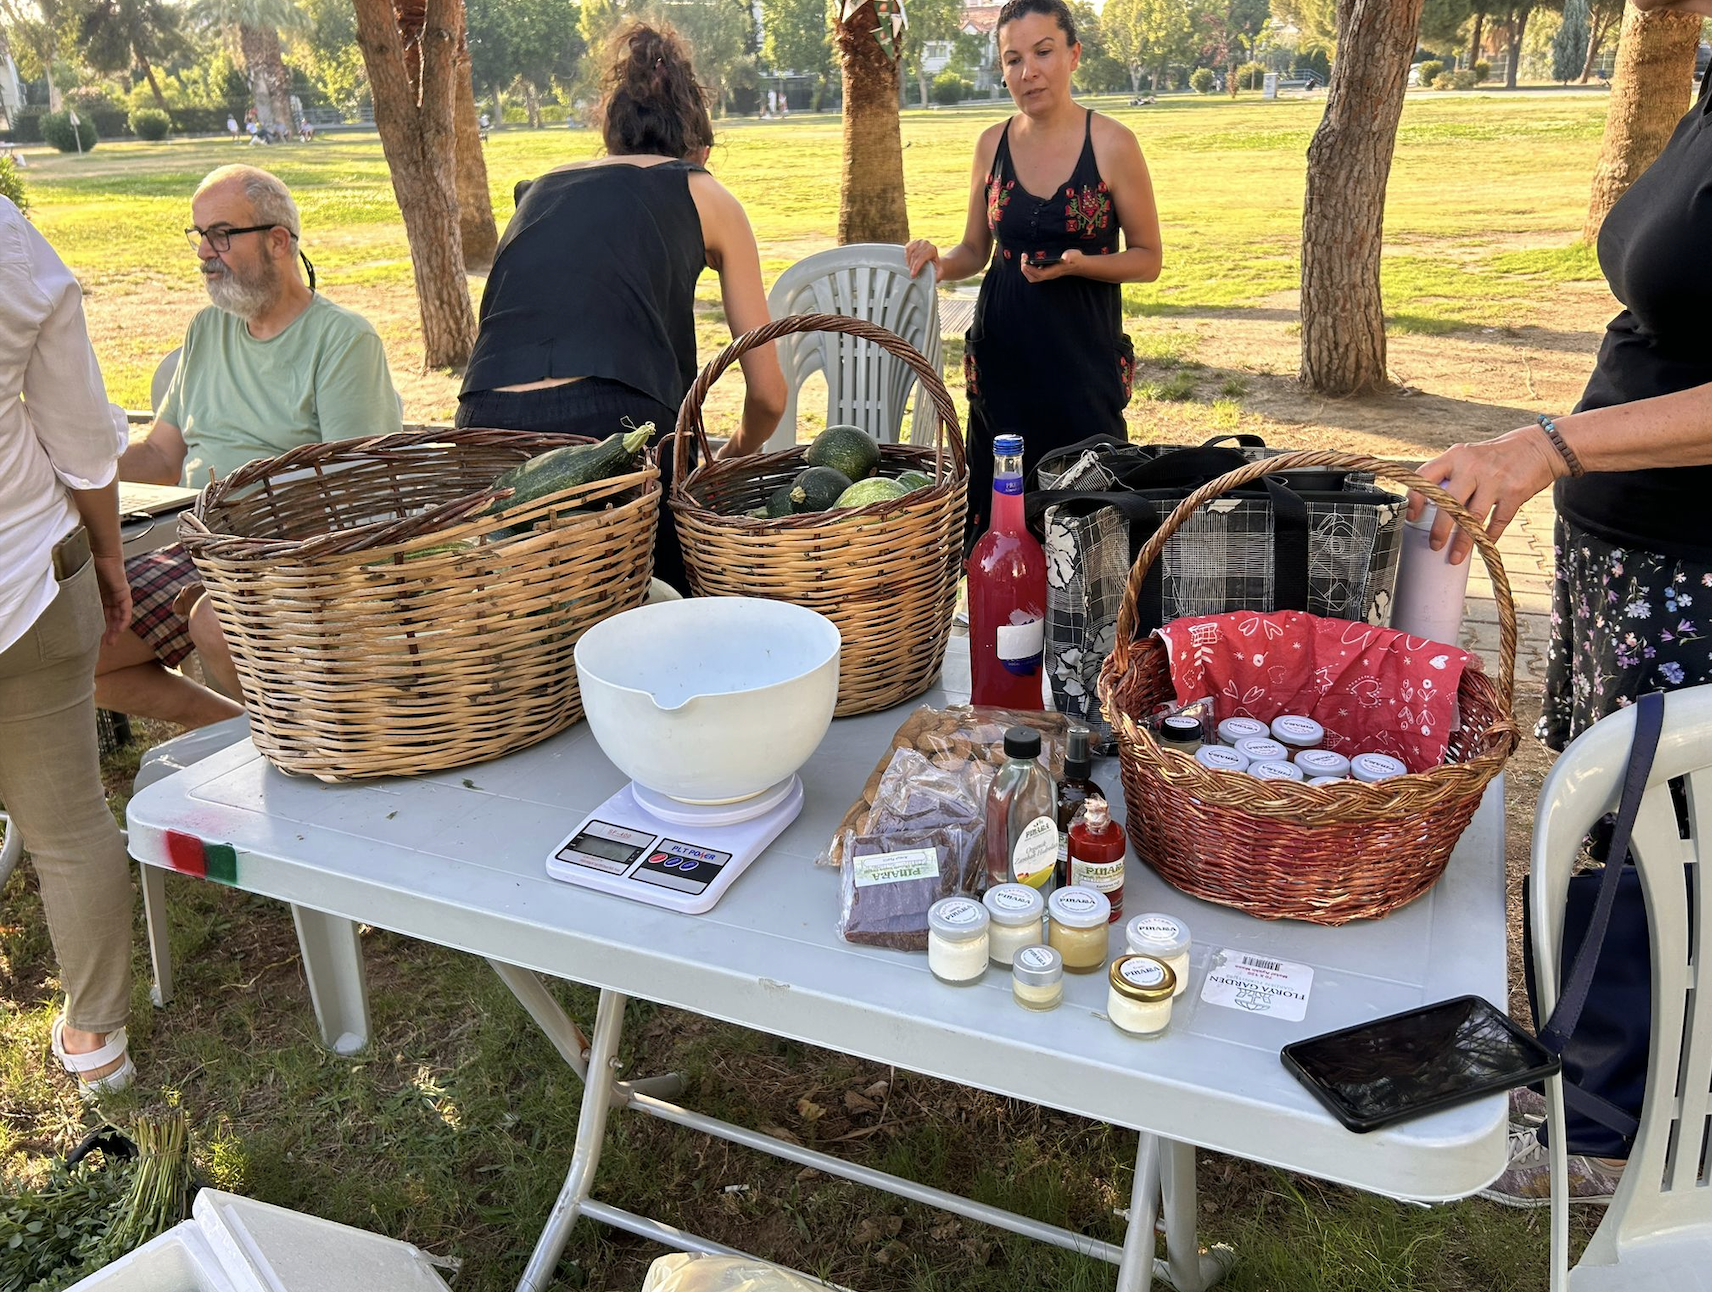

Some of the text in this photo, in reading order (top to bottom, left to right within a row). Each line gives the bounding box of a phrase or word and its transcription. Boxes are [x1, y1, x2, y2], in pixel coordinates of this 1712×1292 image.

[1283, 721, 1314, 730] PINARA
[1208, 752, 1239, 762] PINARA
[1262, 765, 1291, 777] PINARA
[1364, 759, 1395, 771] PINARA
[671, 845, 690, 854] PLT
[871, 867, 922, 881] PINARA
[1086, 862, 1122, 875] PINAR
[997, 892, 1031, 904] PINARA
[944, 904, 974, 921] PINARA
[1028, 948, 1046, 966] PINARA
[1124, 966, 1161, 977] PINARA
[1209, 975, 1306, 1001] FLORYA GARDEN
[1266, 982, 1294, 991] GARDEN
